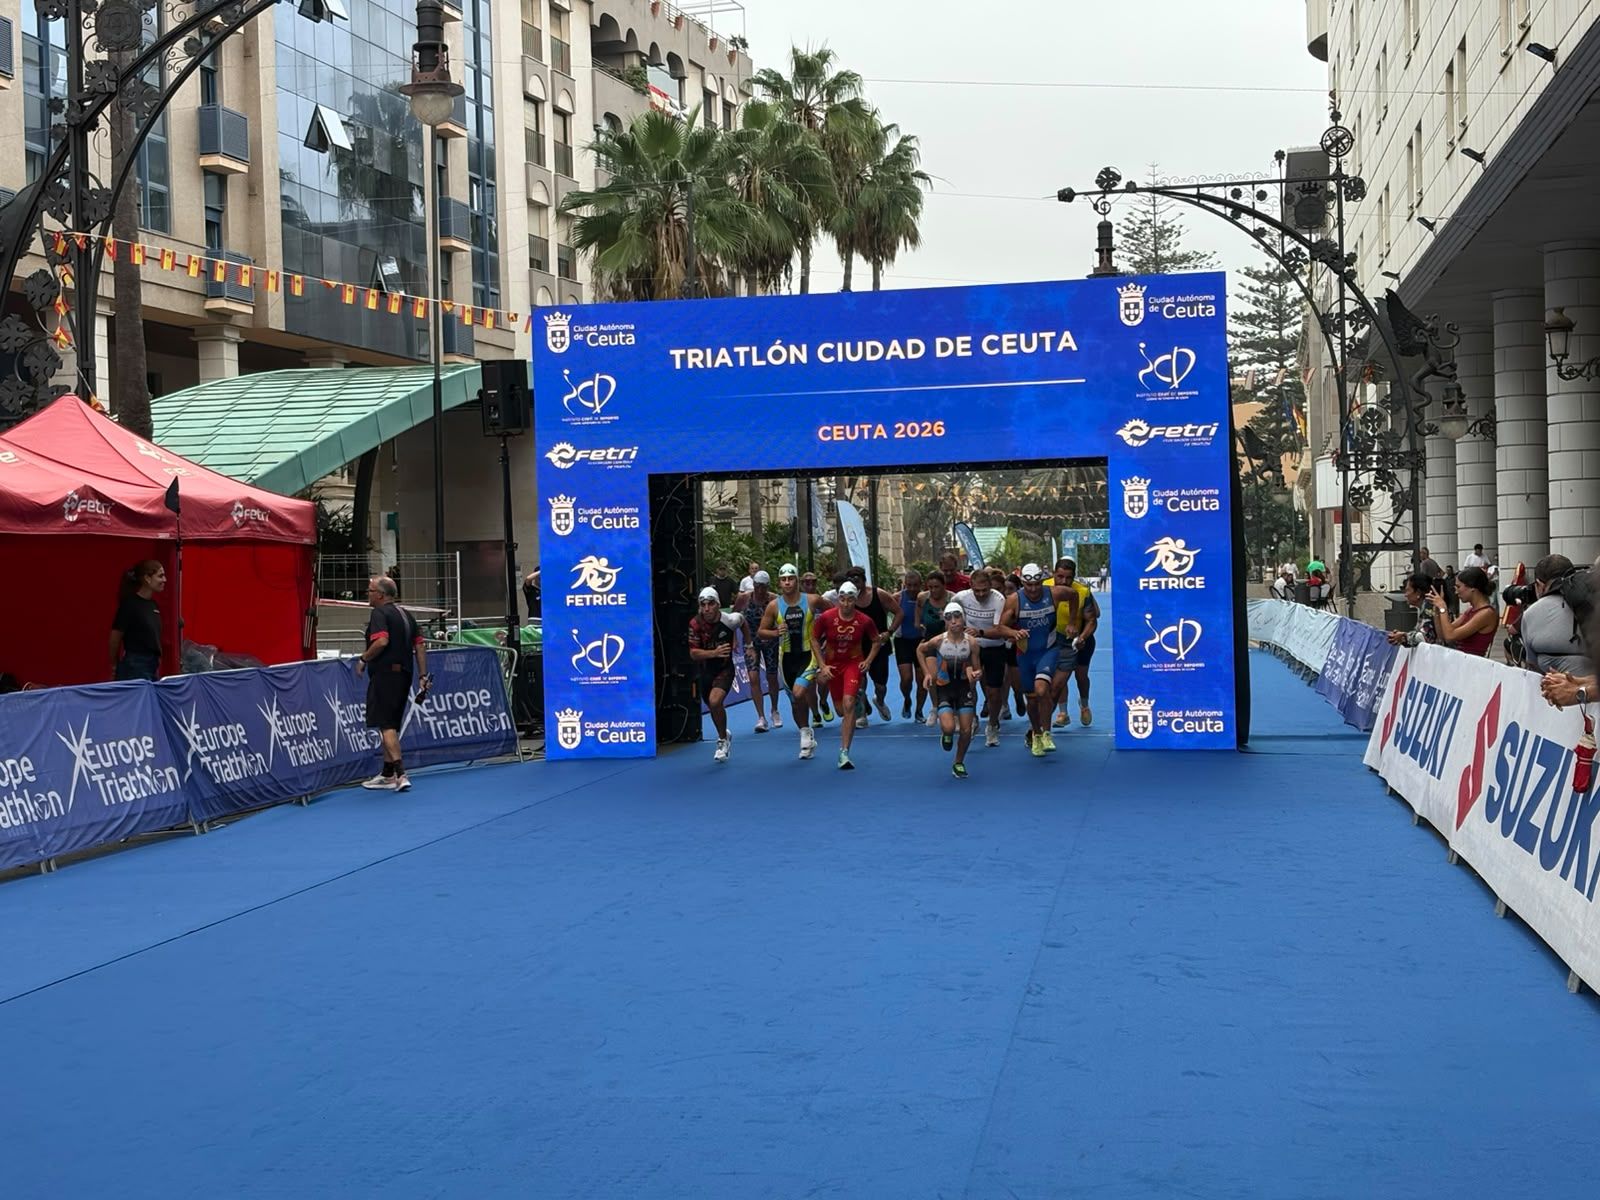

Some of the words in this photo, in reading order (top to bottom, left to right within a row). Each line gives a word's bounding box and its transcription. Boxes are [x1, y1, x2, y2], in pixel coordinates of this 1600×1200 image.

[1163, 302, 1215, 318] Ceuta
[587, 332, 635, 346] Ceuta
[670, 340, 807, 369] TRIATLÓN
[817, 339, 925, 363] CIUDAD
[936, 336, 972, 357] DE
[982, 331, 1077, 355] CEUTA
[818, 424, 887, 441] CEUTA
[894, 421, 945, 438] 2026
[1167, 497, 1219, 512] Ceuta
[591, 513, 639, 529] Ceuta
[1140, 577, 1205, 590] FETRICE
[566, 594, 626, 606] FETRICE
[422, 689, 491, 713] Europe
[275, 711, 317, 744] Europe
[424, 711, 511, 740] Triathlon
[597, 727, 645, 743] Ceuta
[1171, 718, 1223, 732] Ceuta
[1393, 676, 1463, 780] SUZUKI
[194, 722, 248, 753] Europe
[84, 736, 155, 770] Europe
[201, 750, 269, 784] Triathlon
[92, 764, 181, 806] Triathlon
